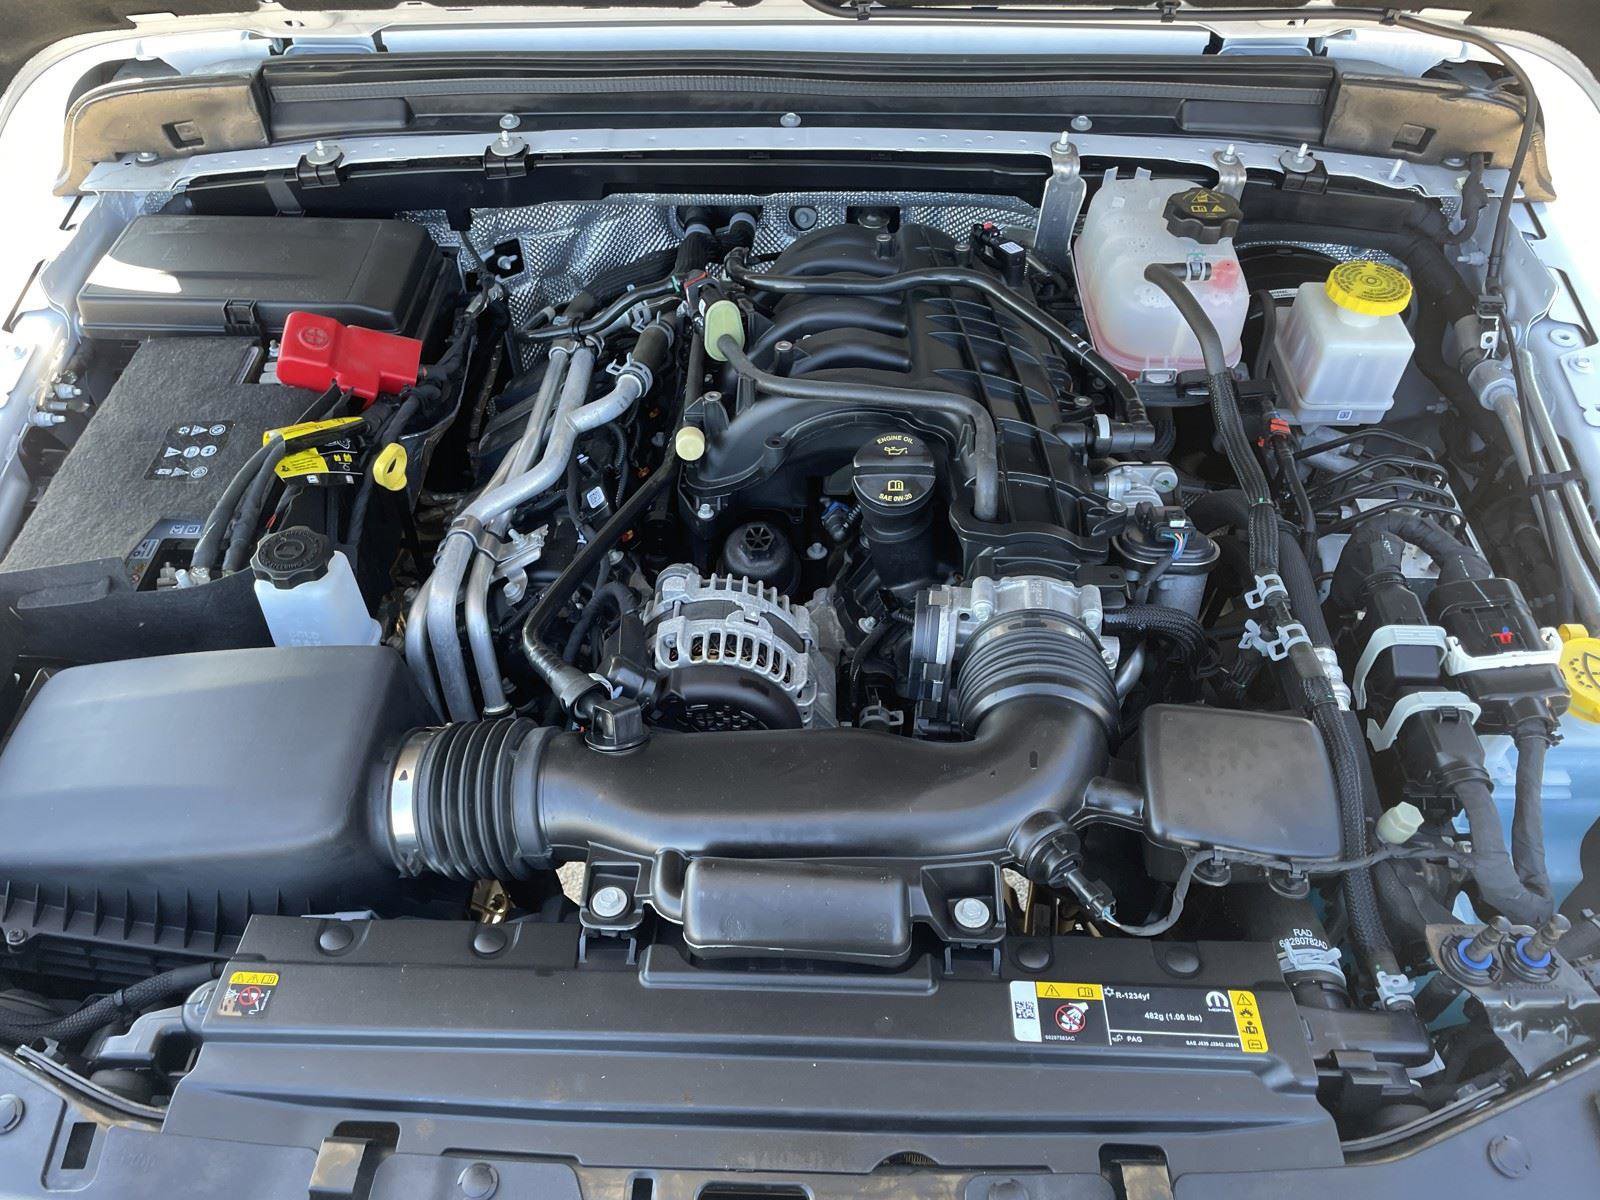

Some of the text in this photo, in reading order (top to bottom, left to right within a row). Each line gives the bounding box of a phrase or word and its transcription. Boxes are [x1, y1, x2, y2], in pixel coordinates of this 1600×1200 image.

[876, 435, 914, 445] ENGINE OIL
[878, 493, 913, 502] SAE 0W-20
[1292, 928, 1313, 937] RAD
[1115, 991, 1151, 1002] R-1234yf
[1144, 1011, 1165, 1022] 482g
[1186, 1013, 1203, 1023] lbs)
[1126, 1035, 1143, 1043] PAG
